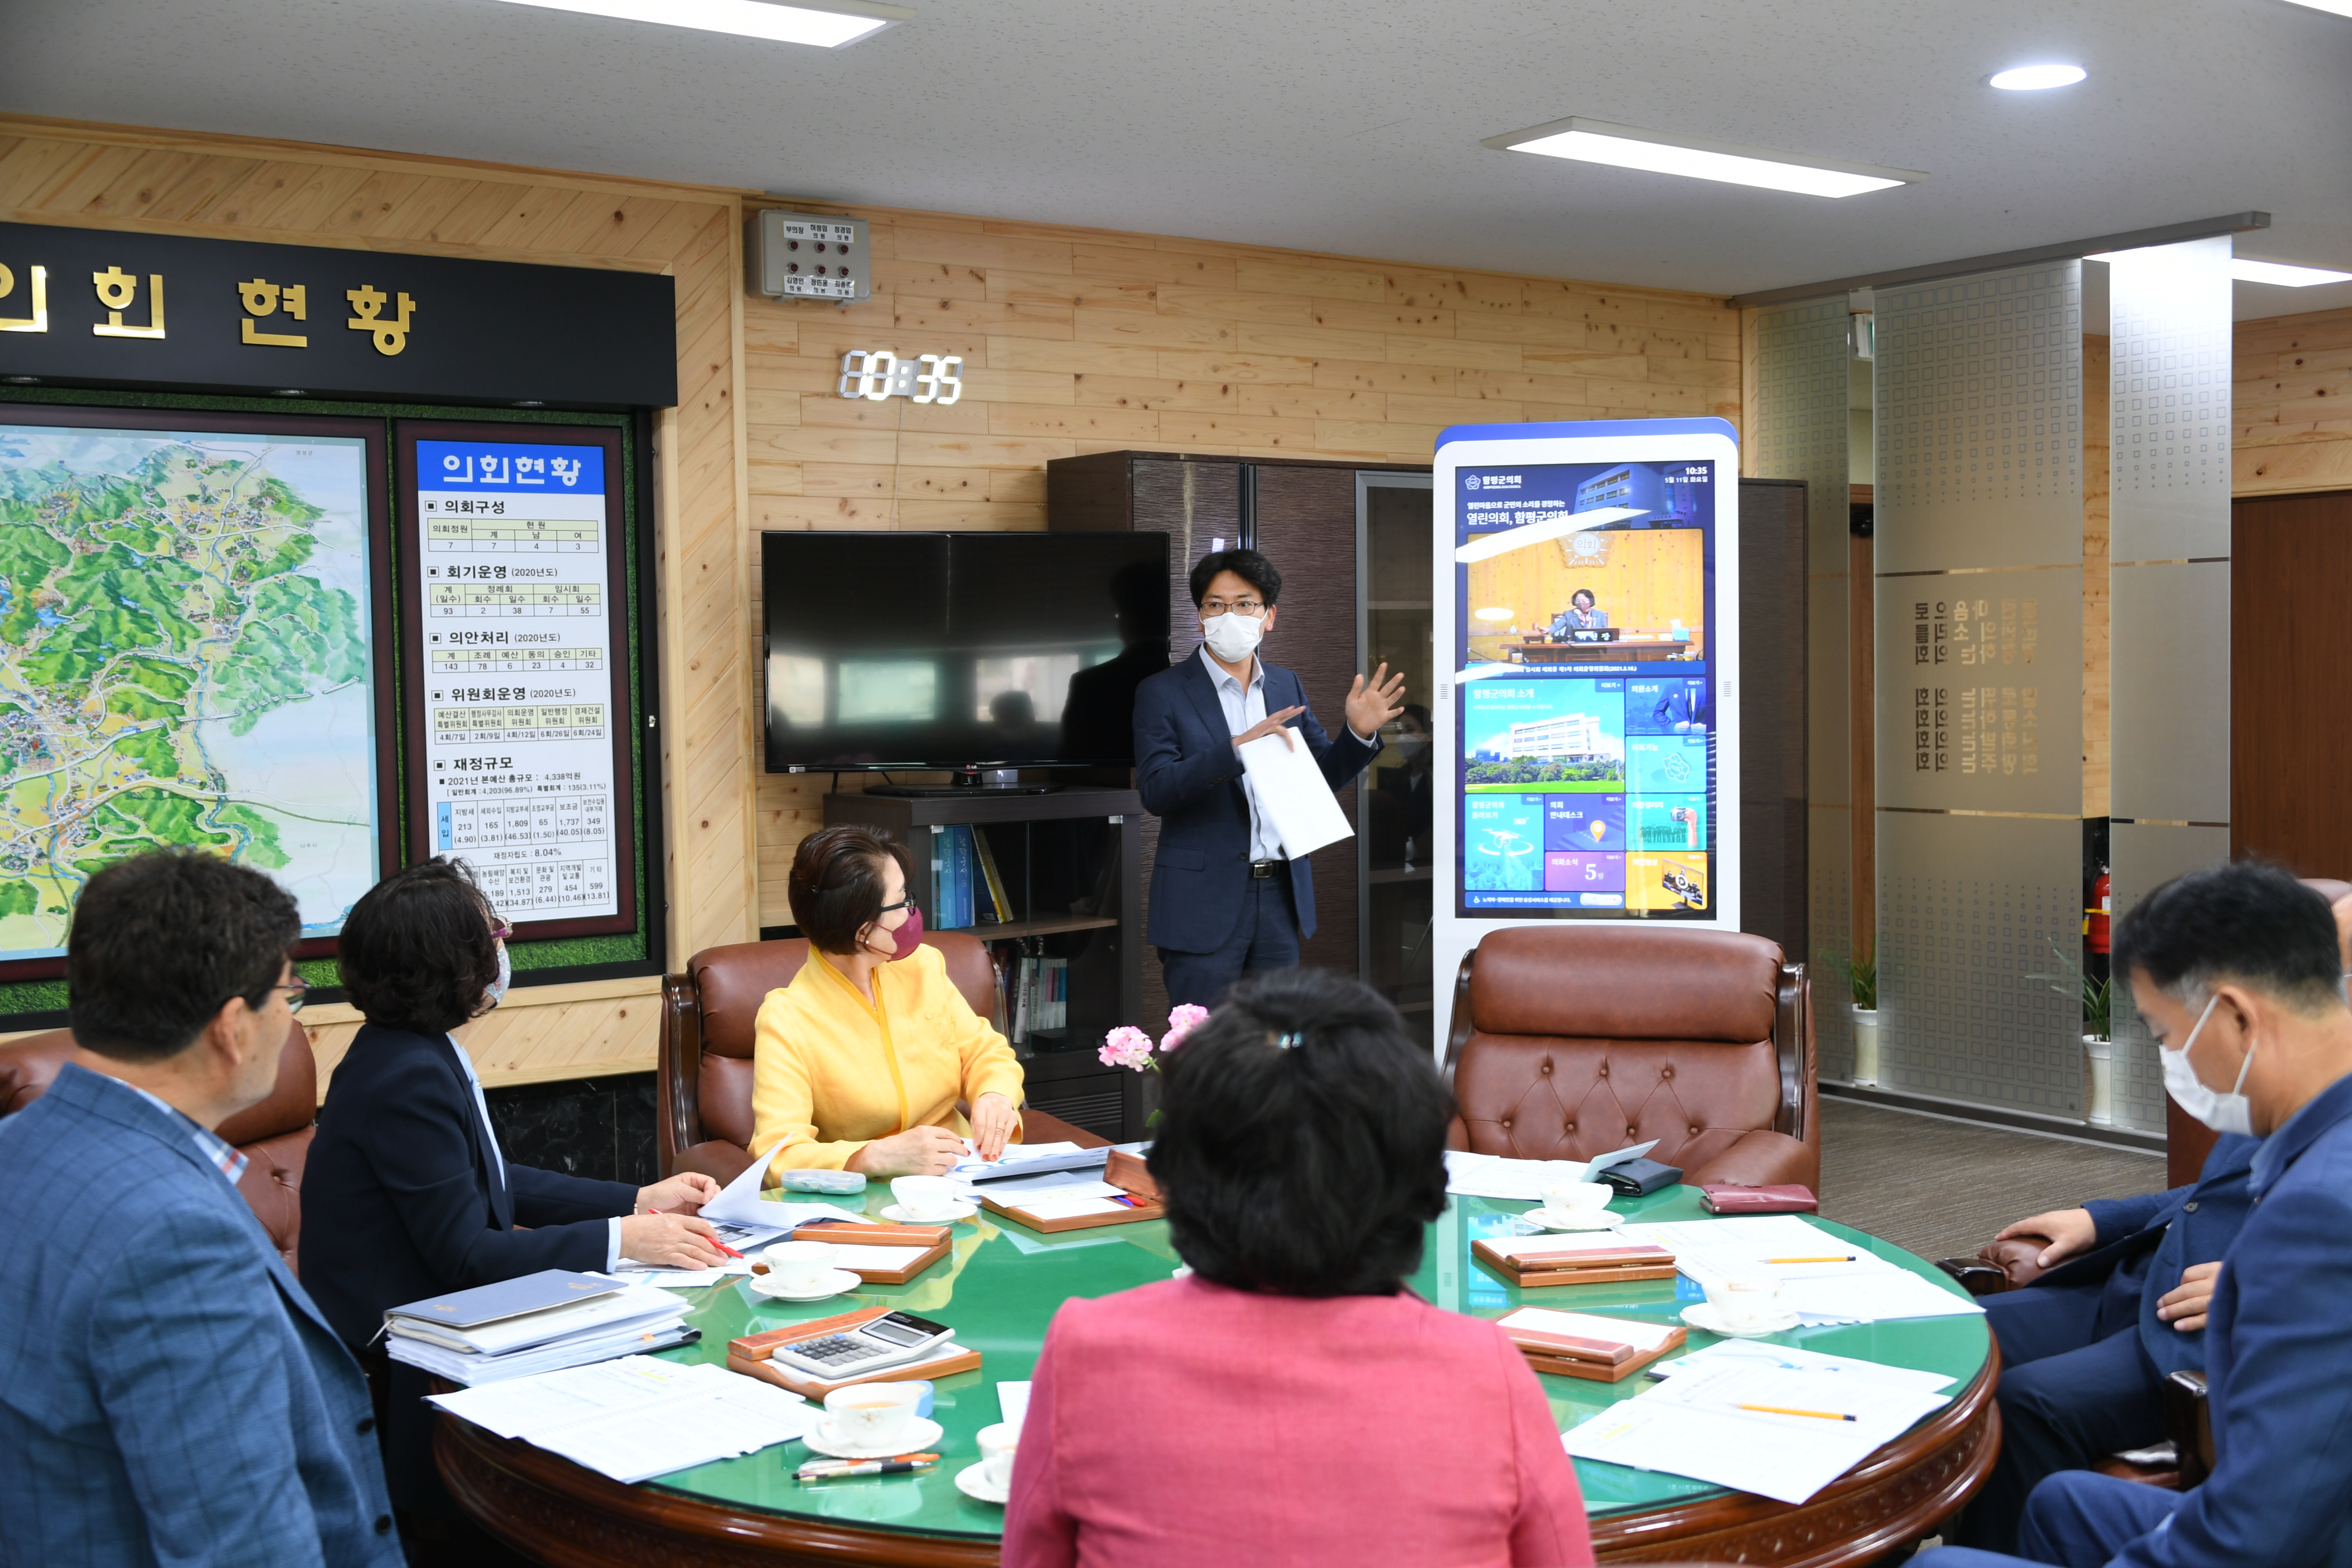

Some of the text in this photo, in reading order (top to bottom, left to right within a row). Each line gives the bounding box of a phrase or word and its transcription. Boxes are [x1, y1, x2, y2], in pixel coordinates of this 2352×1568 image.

[786, 225, 804, 234] 부의장
[238, 278, 416, 356] 현황
[859, 351, 961, 404] 10:35
[443, 455, 581, 486] 의회현황
[1685, 466, 1707, 475] 10:35
[1482, 475, 1522, 485] 함평군의회
[445, 500, 505, 514] 의회구성
[1522, 500, 1541, 508] 소리를
[1467, 512, 1513, 525] 열린의회,
[433, 525, 468, 533] 의회정원
[447, 565, 558, 579] 회기운영 (2020년도)
[436, 595, 461, 603] (일수)
[509, 595, 525, 603] 일수
[576, 595, 592, 603] 일수
[449, 631, 561, 645] 의안처리 (2020년도)
[501, 651, 518, 659] 예산
[554, 650, 570, 658] 승인
[580, 650, 596, 658] 기타
[1631, 685, 1658, 693] 의원소개
[452, 687, 576, 702] 위원회운영 (2020년도)
[1473, 688, 1534, 699] 함평군의회 소개
[438, 710, 466, 719] 예산결산
[471, 709, 502, 717] 행정사무감사
[507, 708, 534, 716] 의회운영
[541, 708, 567, 716] 일반행정
[574, 706, 600, 715] 경제건설
[438, 720, 468, 728] 특별위원회
[472, 719, 502, 727] 특별위원회
[511, 718, 531, 726] 위원회
[545, 717, 565, 725] 위원회
[578, 716, 598, 724] 위원회
[474, 732, 500, 740] 2회/9일
[506, 731, 536, 739] 4회/12일
[573, 729, 602, 737] 6회/24일
[454, 757, 514, 771] 재정규모
[448, 772, 581, 786] 2021년 본예산 총규모 4,338억원
[455, 808, 474, 816] 지방세
[507, 820, 528, 828] 1,809
[559, 818, 580, 826] 1,737
[458, 823, 472, 831] 213
[533, 830, 555, 839] (1.50)
[556, 828, 583, 837] (40.05)
[583, 827, 605, 836] (8.05)
[454, 836, 476, 844] (4.90)
[481, 834, 503, 842] (3.81)
[505, 832, 531, 841] (46.53)
[493, 848, 562, 859] 재정자립도 8.04%
[560, 864, 582, 872] 지역개발
[482, 869, 505, 877] 농림해양
[536, 896, 557, 904] (6.44)
